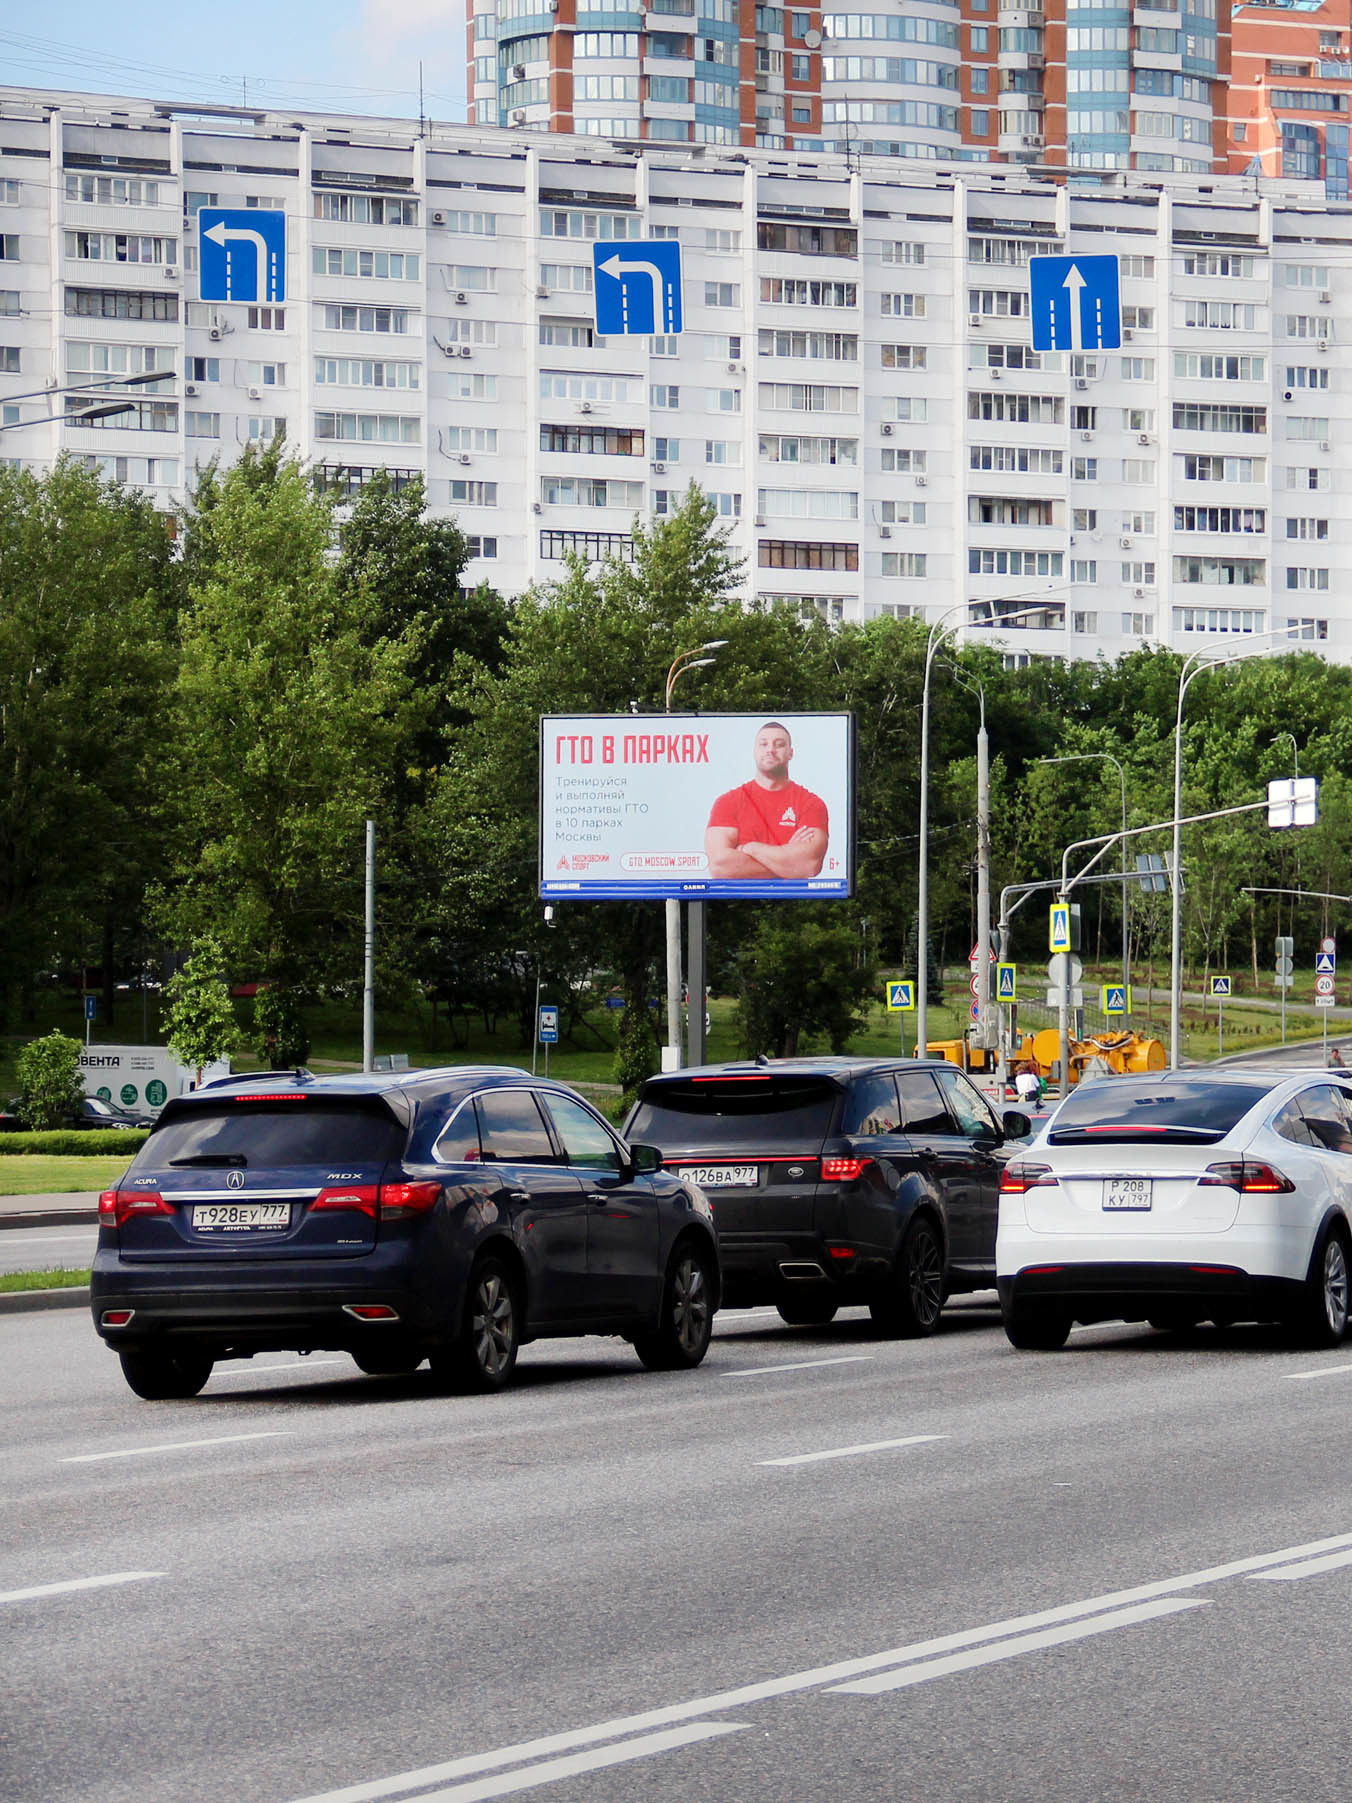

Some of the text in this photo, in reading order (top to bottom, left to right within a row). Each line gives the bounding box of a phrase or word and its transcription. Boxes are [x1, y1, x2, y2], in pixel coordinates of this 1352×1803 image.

[556, 734, 709, 764] ГТО В ПАРКАХ
[555, 776, 627, 788] Тренируйся
[555, 790, 625, 800] и выполняй
[555, 803, 649, 816] нормативы ГТО
[555, 817, 623, 829] в 10 парках
[555, 831, 602, 841] Москвы
[829, 857, 840, 870] 6+
[1320, 981, 1330, 990] 20
[734, 1167, 754, 1178] 977
[1123, 1181, 1144, 1192] 208
[1132, 1195, 1148, 1203] 797
[262, 1205, 286, 1217] 777
